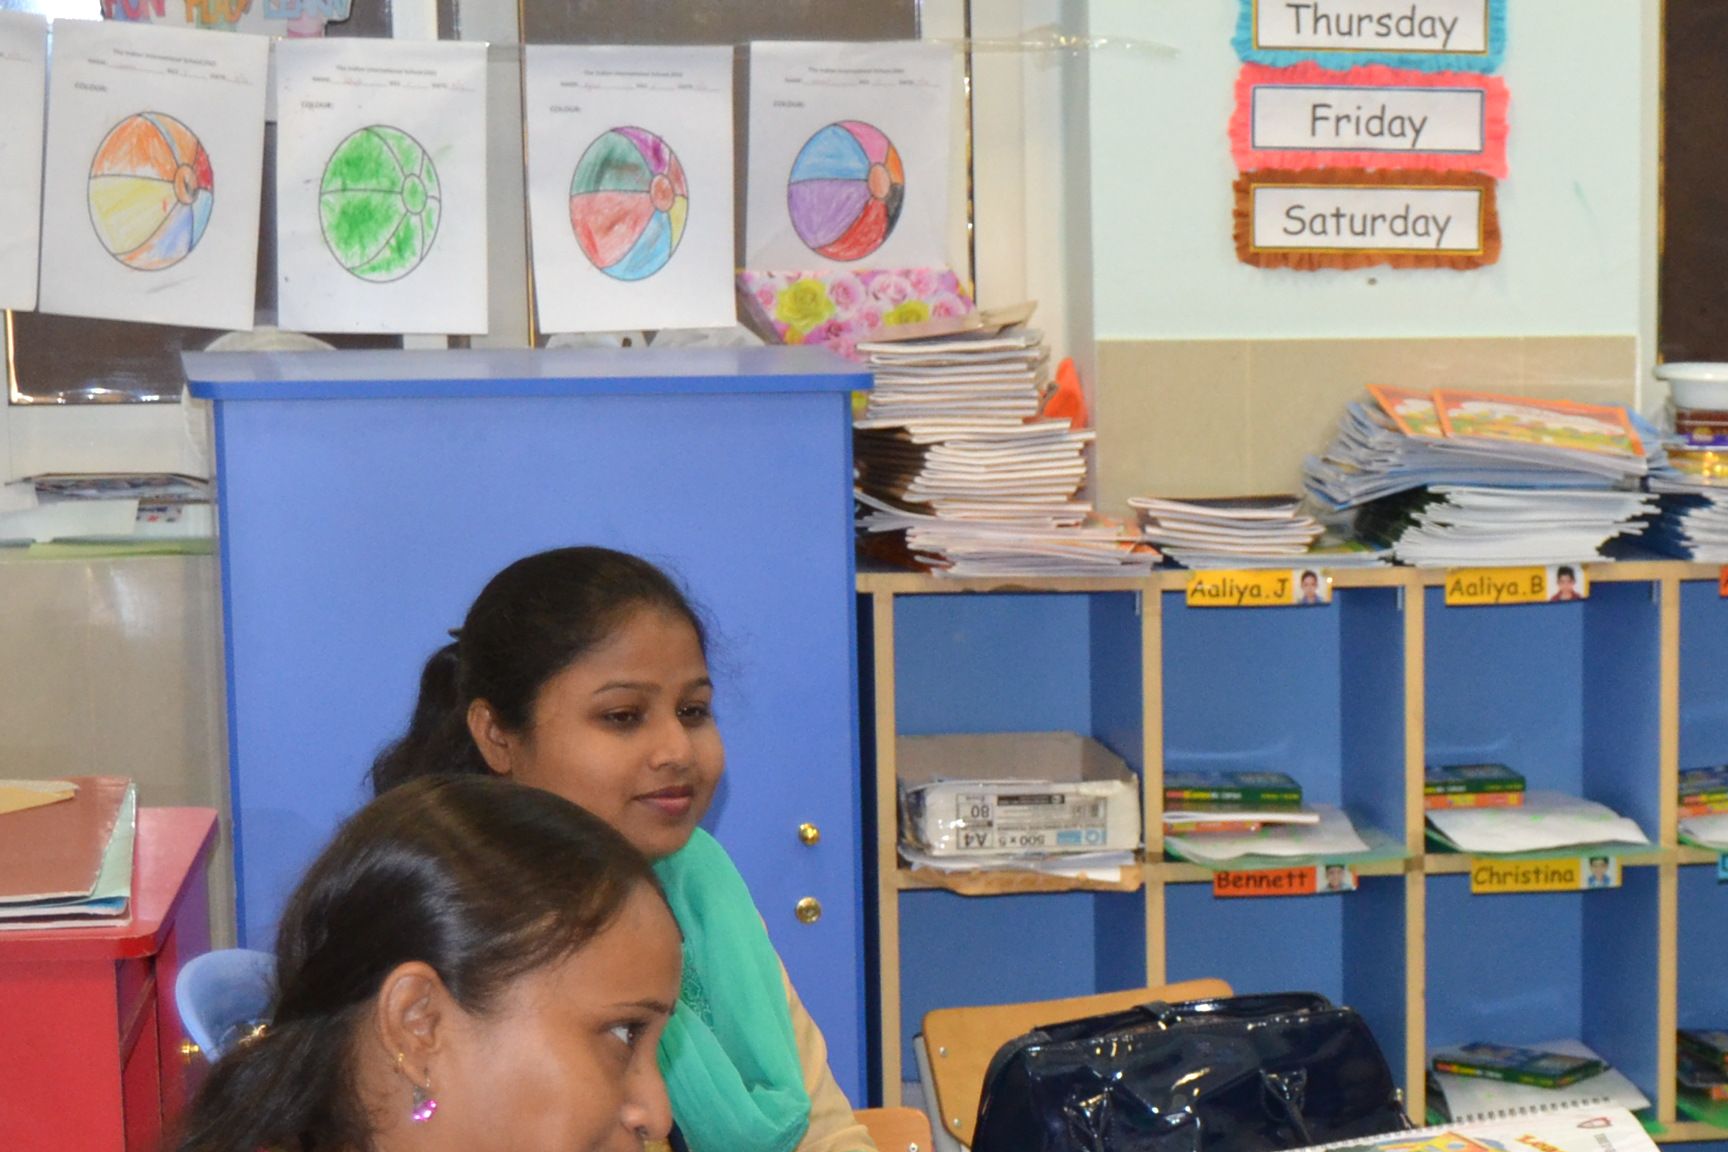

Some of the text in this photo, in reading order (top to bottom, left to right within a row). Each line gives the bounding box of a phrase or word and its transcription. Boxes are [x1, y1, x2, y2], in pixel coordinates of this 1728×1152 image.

[1286, 2, 1459, 49] Thursday
[1310, 103, 1428, 148] Friday
[1283, 204, 1452, 248] Saturday
[1189, 578, 1289, 605] Aaliya.J
[1449, 575, 1545, 602] Aaliya.B
[1215, 867, 1309, 889] Bennett
[1473, 865, 1575, 886] Christina
